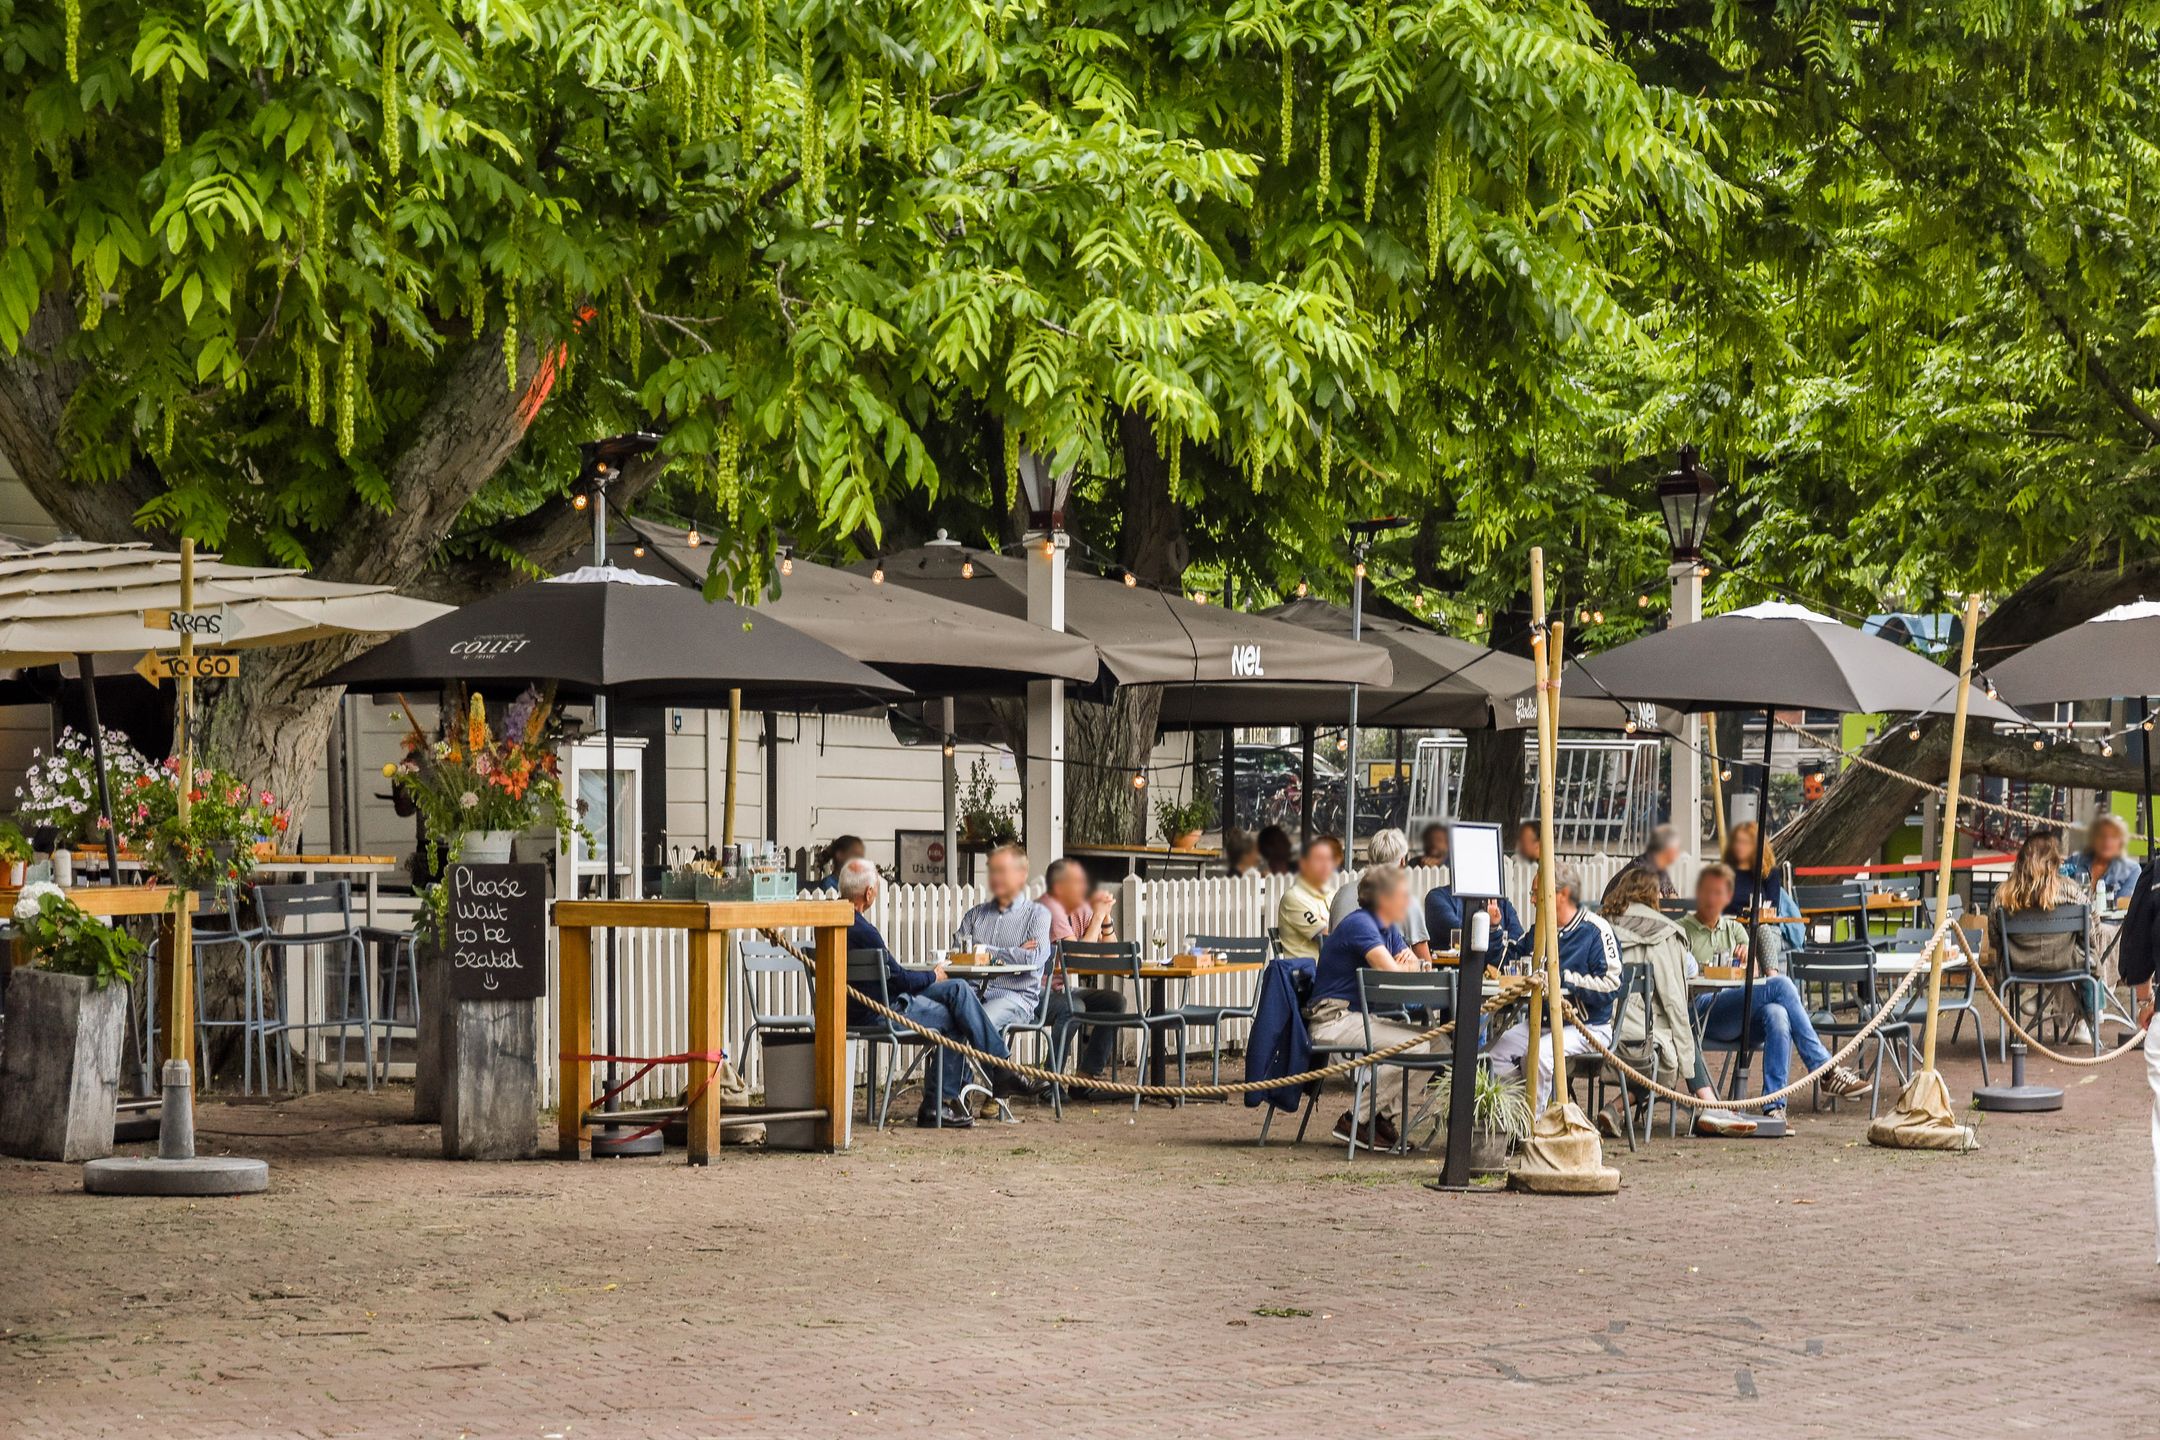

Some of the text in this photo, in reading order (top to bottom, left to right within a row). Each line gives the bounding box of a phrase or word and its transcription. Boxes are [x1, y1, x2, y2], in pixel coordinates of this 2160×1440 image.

[450, 640, 531, 654] COLLET
[160, 656, 231, 676] TO GO
[455, 866, 527, 898] Please
[1303, 911, 1317, 924] 2
[455, 922, 511, 943] to be
